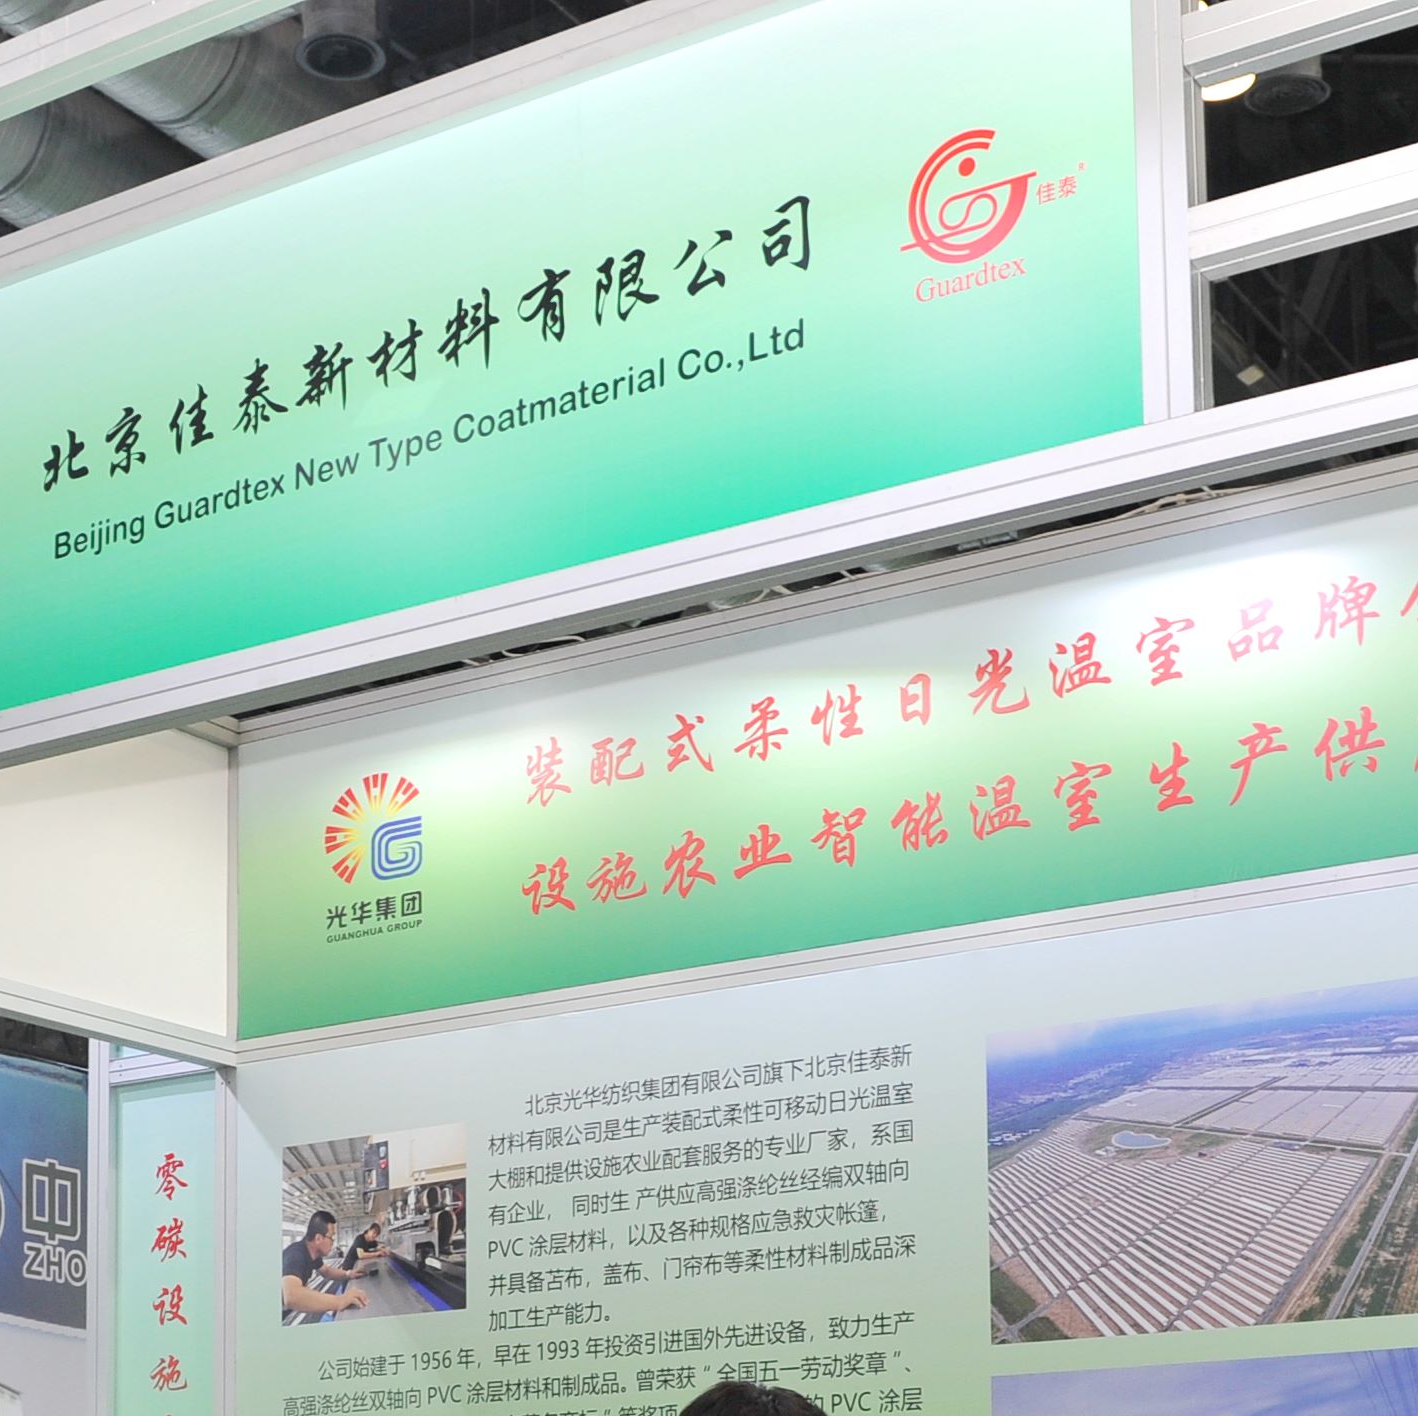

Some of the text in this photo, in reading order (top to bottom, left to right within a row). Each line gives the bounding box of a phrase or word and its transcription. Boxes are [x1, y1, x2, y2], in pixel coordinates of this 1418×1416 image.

[1036, 176, 1077, 205] 佳泰
[916, 258, 1026, 303] Guardtex
[41, 195, 815, 496] 北京佳泰新材料有限公司
[53, 317, 806, 561] Beijing Guardtex New Type Coatmaterial Co.,Ltd
[327, 891, 422, 929] 光华集团
[327, 919, 422, 943] GUANGHUA GROUP
[525, 1044, 912, 1117] 北京光华纺织集团有限公司旗下北京佳泰新
[488, 1082, 913, 1157] 材料有限公司是生产装配式柔性可移动日光温室
[488, 1121, 913, 1191] 大棚和提供设施农业配套服务的专业厂家，系国
[22, 1241, 88, 1287] ZHO
[488, 1236, 523, 1259] PVC
[488, 1302, 612, 1332] 加工生产能力。
[318, 1355, 406, 1381] 公司始建于
[411, 1350, 451, 1372] 1956
[537, 1340, 580, 1361] 1993
[427, 1385, 462, 1405] PVC
[832, 1391, 870, 1412] PVC
[878, 1387, 923, 1414] 涂层
